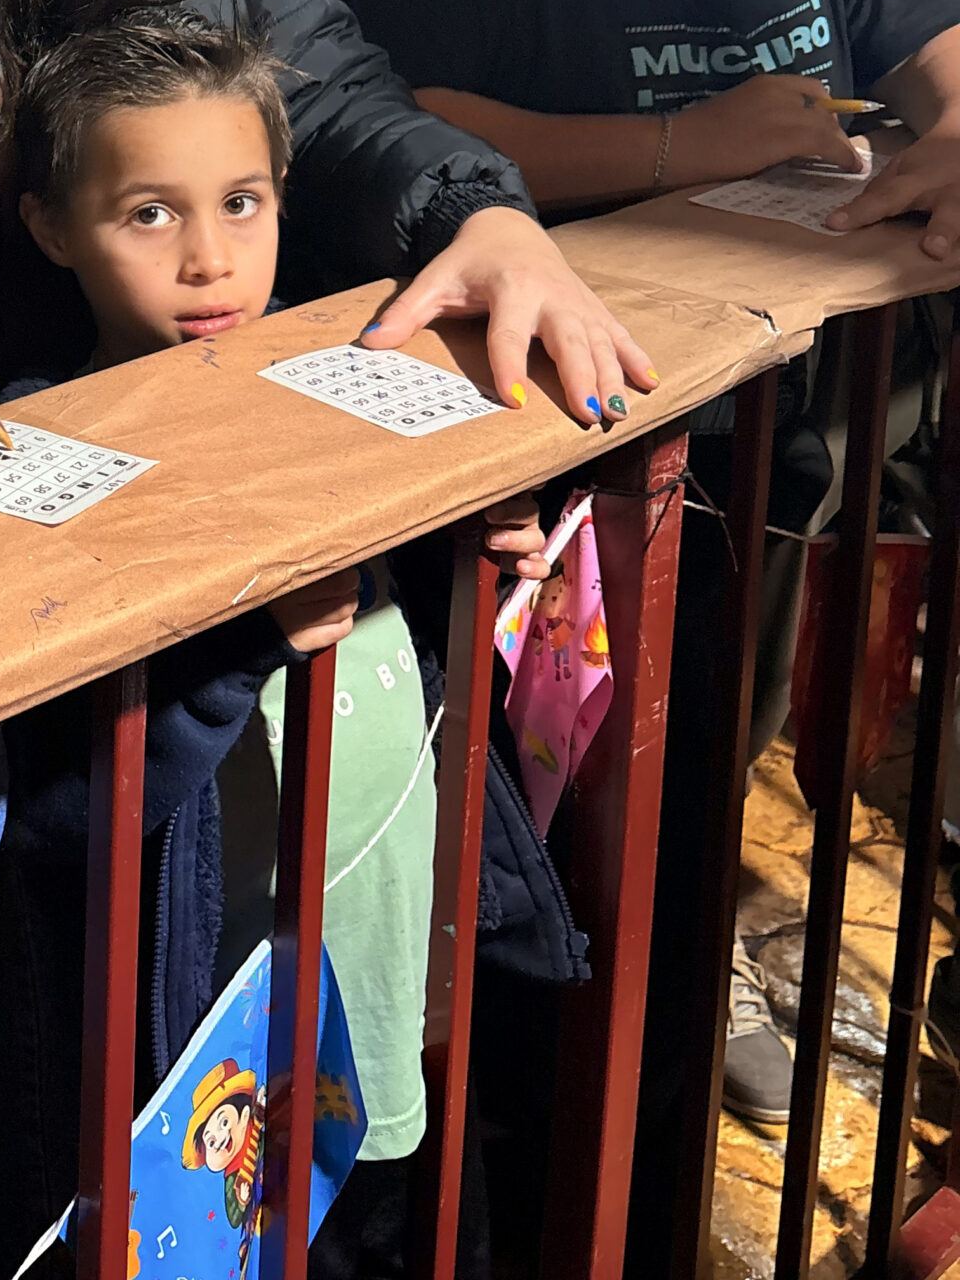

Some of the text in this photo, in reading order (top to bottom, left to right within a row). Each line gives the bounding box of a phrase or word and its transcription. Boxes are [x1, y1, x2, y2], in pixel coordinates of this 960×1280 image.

[283, 368, 302, 377] 72
[22, 462, 41, 472] 33
[69, 461, 89, 471] 21
[3, 473, 22, 483] 54
[53, 472, 71, 483] 37
[33, 484, 52, 494] 58
[14, 496, 32, 506] 69
